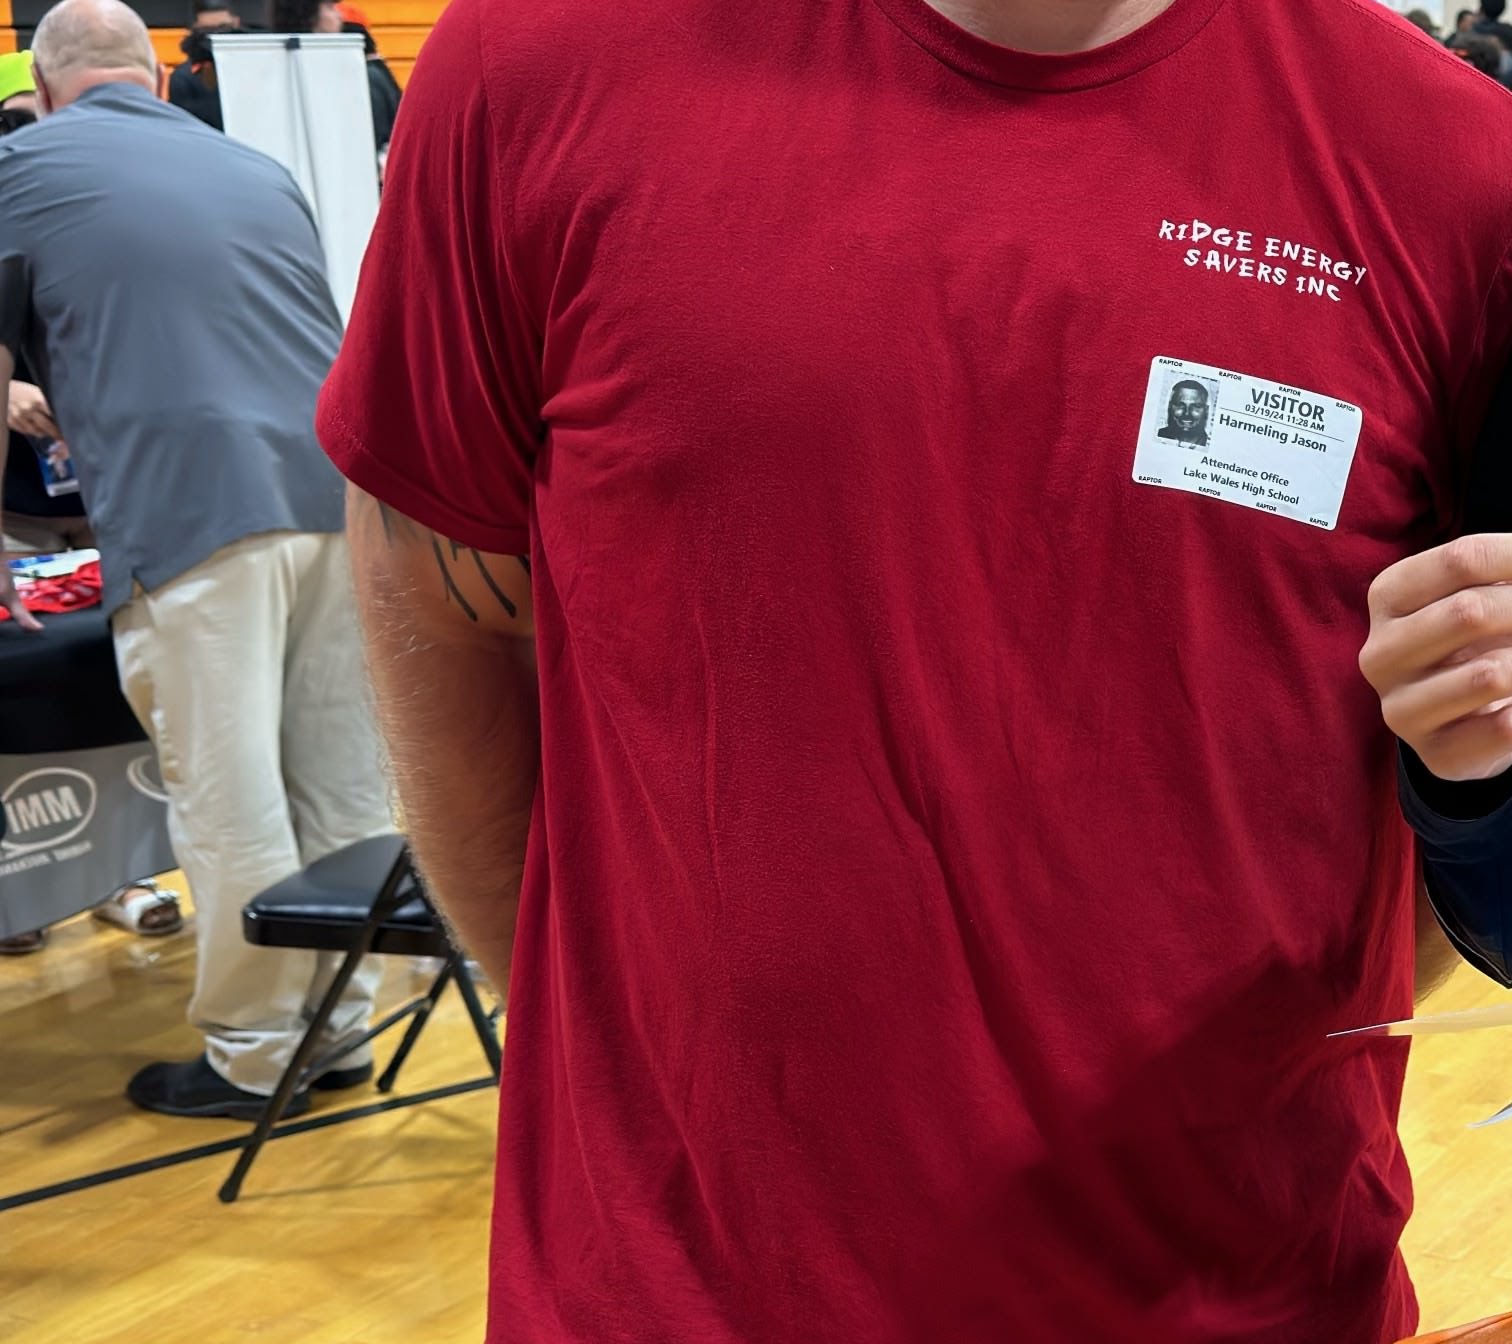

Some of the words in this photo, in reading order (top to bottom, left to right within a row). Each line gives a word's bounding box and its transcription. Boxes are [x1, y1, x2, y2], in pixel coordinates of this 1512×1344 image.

[1158, 219, 1254, 251] RIDGE
[1264, 236, 1368, 286] ENERGY
[1184, 248, 1288, 286] SAVERS
[1295, 275, 1341, 302] INC
[1159, 358, 1183, 368] RAPTOR
[1218, 370, 1242, 382] RAPTOR
[1279, 386, 1301, 397] RAPTOR
[1251, 388, 1325, 423] VISITOR
[1245, 404, 1284, 423] 03/19/24
[1286, 415, 1308, 428] 11:28
[1309, 421, 1325, 432] AM
[1219, 413, 1288, 444] Harmeling
[1291, 430, 1327, 453] Jason
[1138, 475, 1163, 485] RAPTOR
[1200, 456, 1259, 478] Attendance
[1260, 471, 1290, 487] Office
[1183, 467, 1208, 480] Lake
[1210, 473, 1240, 489] Wales
[1241, 480, 1266, 497] High
[1267, 488, 1300, 505] School
[1198, 486, 1221, 497] RAPTOR
[1255, 501, 1277, 512] RAPTOR
[1309, 516, 1329, 528] RAPTOR
